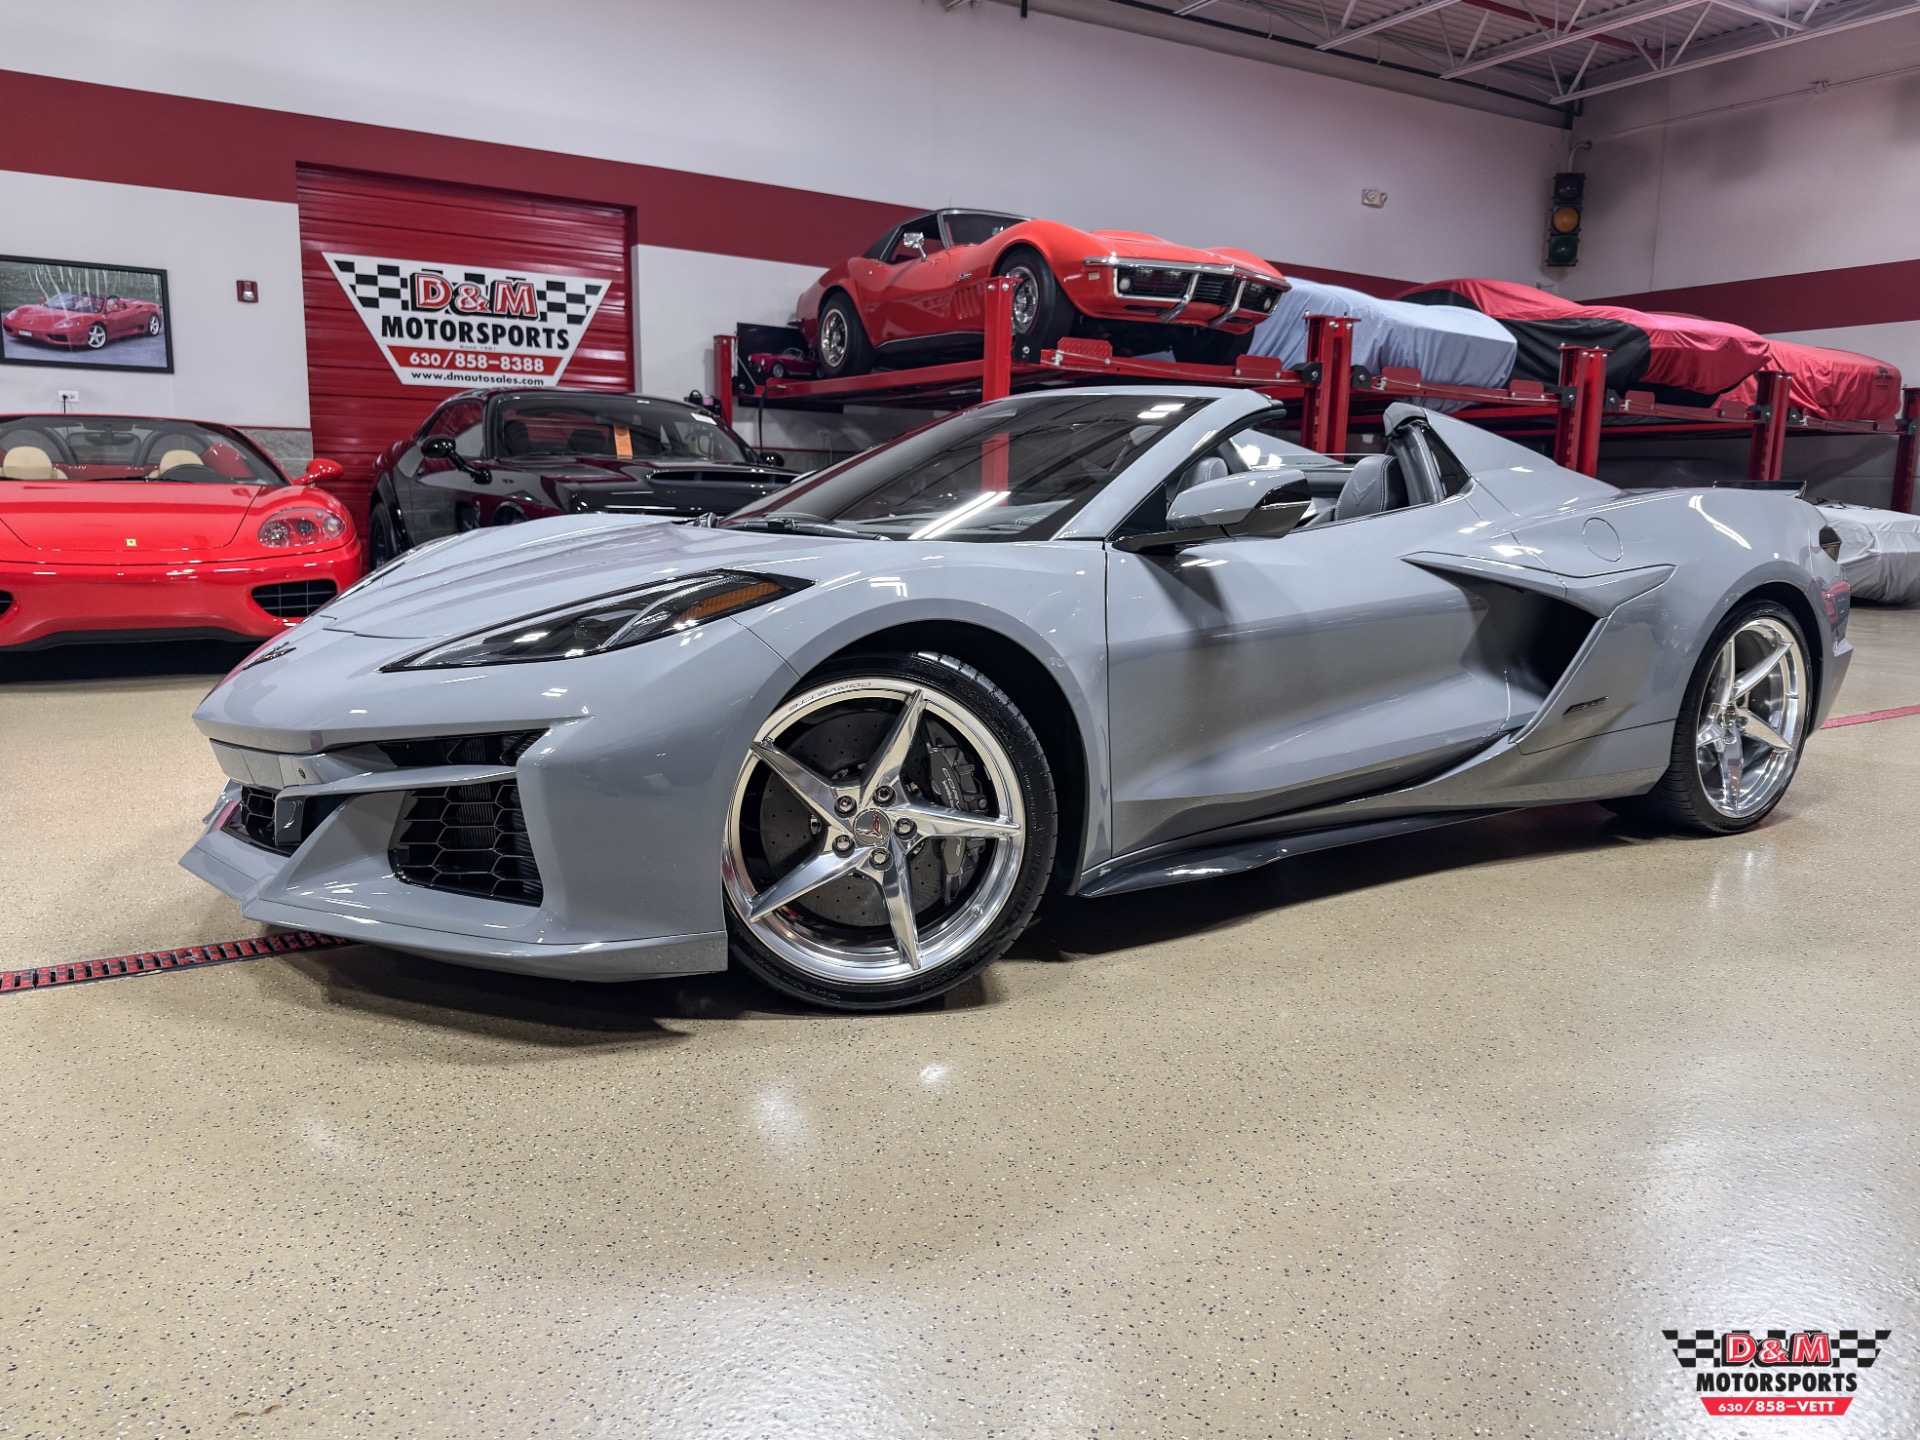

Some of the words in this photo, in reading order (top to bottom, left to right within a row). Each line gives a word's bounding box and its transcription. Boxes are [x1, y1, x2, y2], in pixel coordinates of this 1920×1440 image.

[410, 272, 539, 321] D&M
[381, 315, 570, 350] MOTORSPORTS
[409, 351, 545, 373] 630/858-8388
[411, 370, 545, 387] www.dmautosales.com
